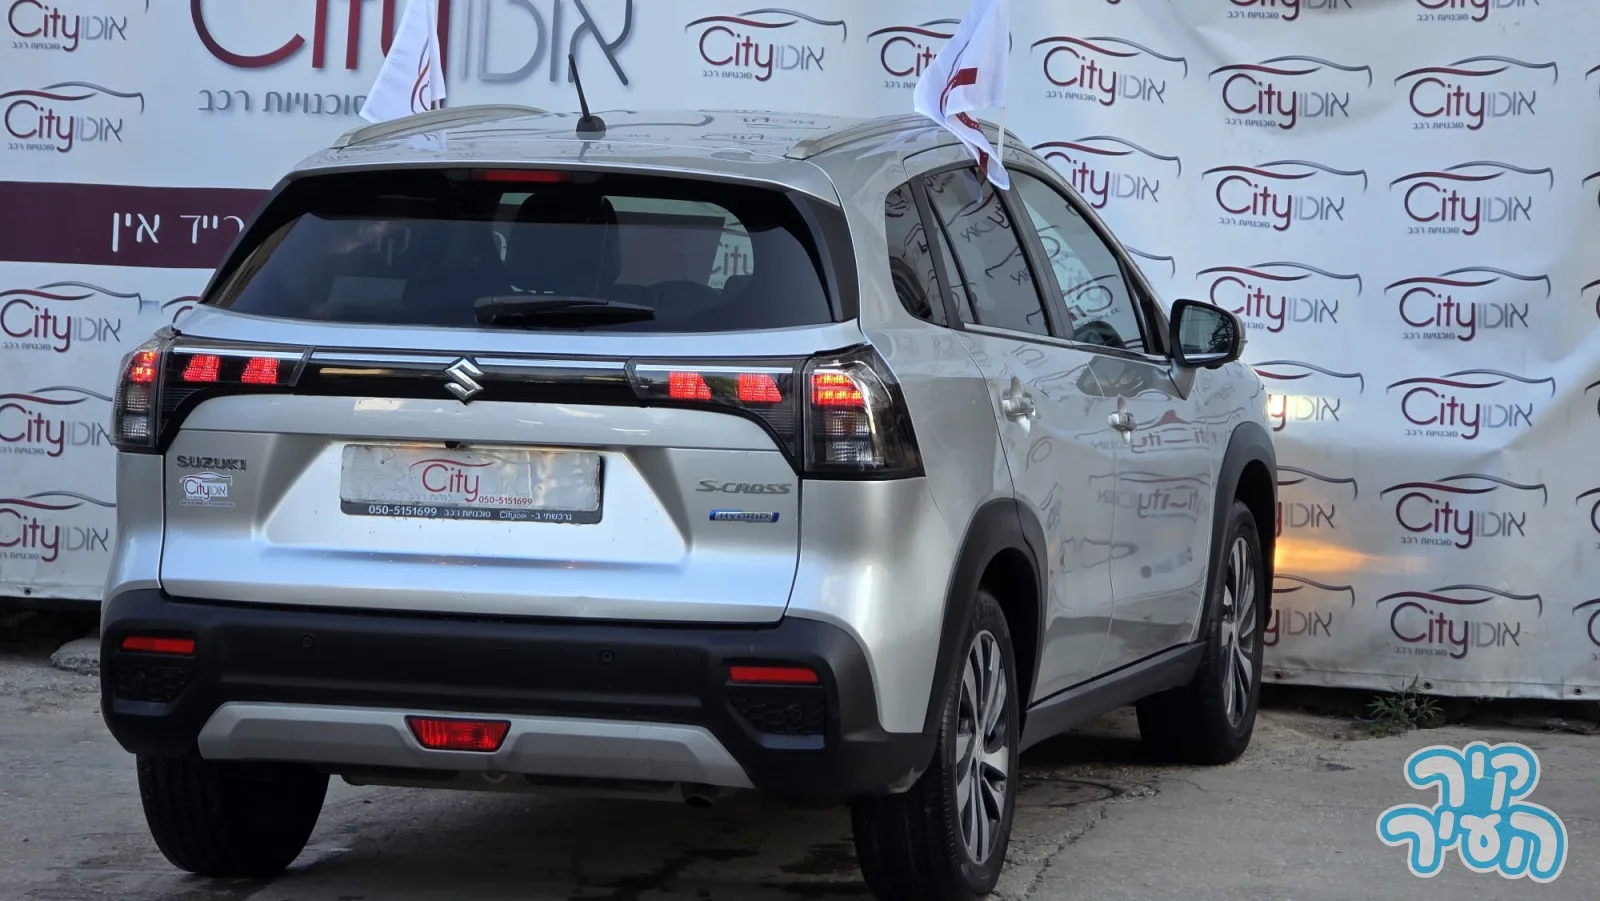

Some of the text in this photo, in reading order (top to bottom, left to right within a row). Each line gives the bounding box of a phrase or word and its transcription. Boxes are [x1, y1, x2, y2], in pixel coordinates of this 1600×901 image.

[8, 0, 80, 51] City
[699, 26, 773, 82] City
[880, 36, 938, 77] Cit
[1043, 46, 1117, 106] City
[5, 100, 74, 152] City
[1222, 73, 1297, 129] City
[1409, 77, 1485, 130] City
[1216, 175, 1292, 231] City
[1404, 181, 1480, 236] City
[112, 212, 245, 253] רייד אין
[0, 299, 71, 352] City
[1210, 276, 1286, 333] City
[1399, 287, 1476, 342] City
[0, 403, 65, 457] City
[1401, 387, 1480, 440] City
[177, 456, 247, 471] SUZUKI
[184, 479, 210, 501] City
[422, 463, 480, 503] City
[695, 479, 792, 495] S-CROSS
[368, 504, 438, 517] 050-5151699
[443, 509, 460, 518] רכב
[478, 495, 533, 506] 050-5151699
[717, 512, 770, 521] HYBRID
[1396, 492, 1473, 549] City
[1390, 601, 1468, 659] City
